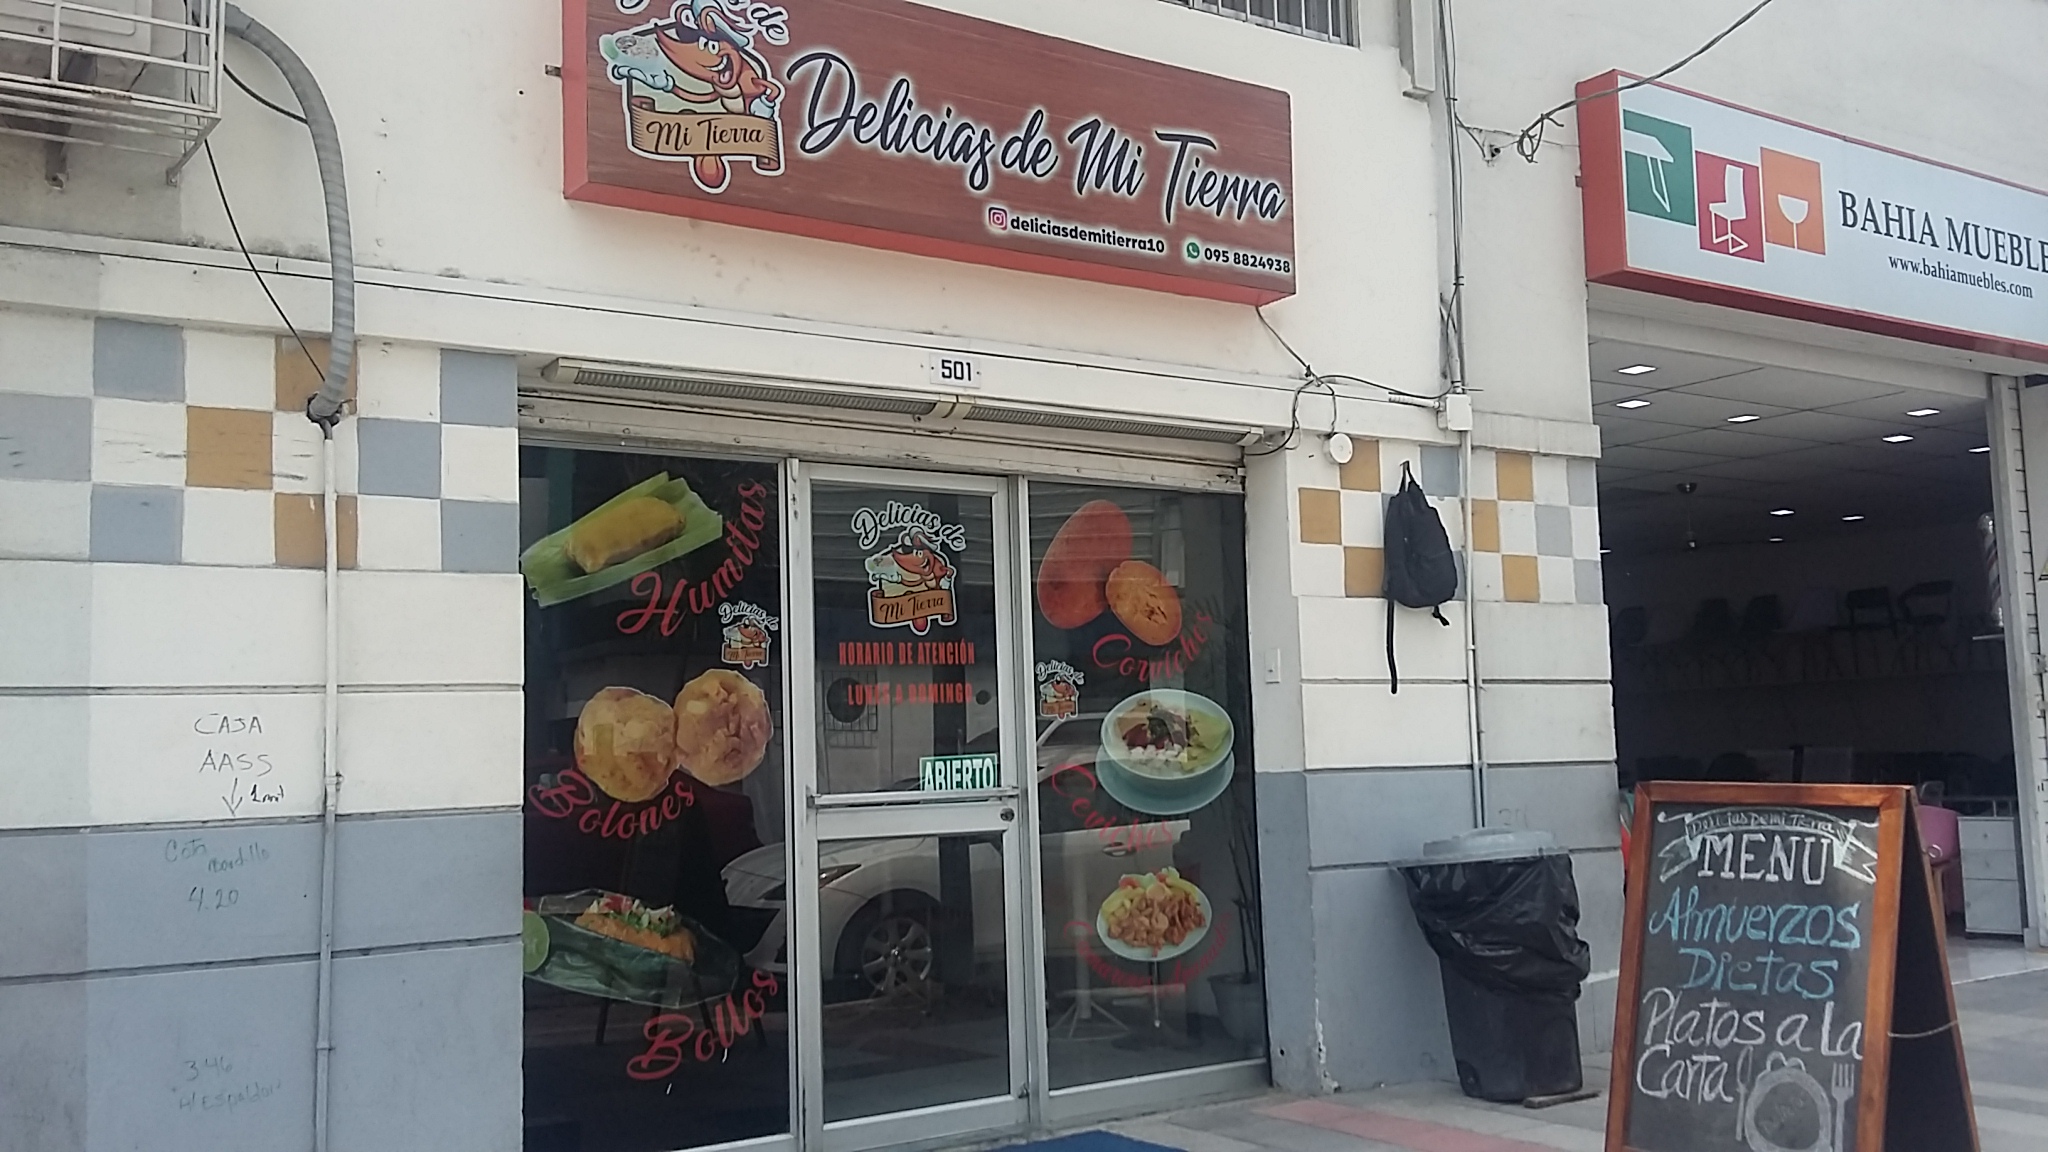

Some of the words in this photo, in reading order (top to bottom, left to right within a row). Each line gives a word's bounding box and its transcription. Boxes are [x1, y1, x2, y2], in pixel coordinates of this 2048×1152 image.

[750, 6, 786, 41] de
[646, 120, 691, 154] Mi
[697, 118, 765, 151] Tierra
[787, 52, 995, 191] Delicias
[1000, 109, 1058, 178] de
[1068, 118, 1145, 195] Mi
[1155, 130, 1285, 224] Tierra
[1010, 215, 1165, 253] deliciasdemitierra10
[1838, 190, 1939, 248] BAHIA
[1204, 246, 1229, 264] 095
[1233, 251, 1291, 273] 8824938
[1889, 256, 2033, 298] www.bahiamuebles.com
[941, 359, 972, 381] 501
[852, 501, 940, 548] Delicias
[940, 525, 967, 550] de
[616, 478, 767, 637] Humitas
[880, 603, 904, 623] Mi
[907, 595, 944, 616] Tierra
[838, 642, 894, 665] HORARIO
[899, 642, 915, 665] DE
[917, 638, 975, 665] ATENCIÓN
[908, 683, 973, 705] DOMINGO
[194, 713, 262, 735] CAJA
[199, 749, 273, 777] AASS
[923, 756, 996, 791] ABIERTO
[528, 769, 694, 839] Bolones
[1697, 833, 1831, 885] MENU
[1678, 947, 1839, 999] Dietas
[626, 968, 778, 1080] Bollos
[1642, 987, 1766, 1049] Platos
[1776, 1013, 1814, 1051] a
[1636, 1044, 1734, 1104] Carta
